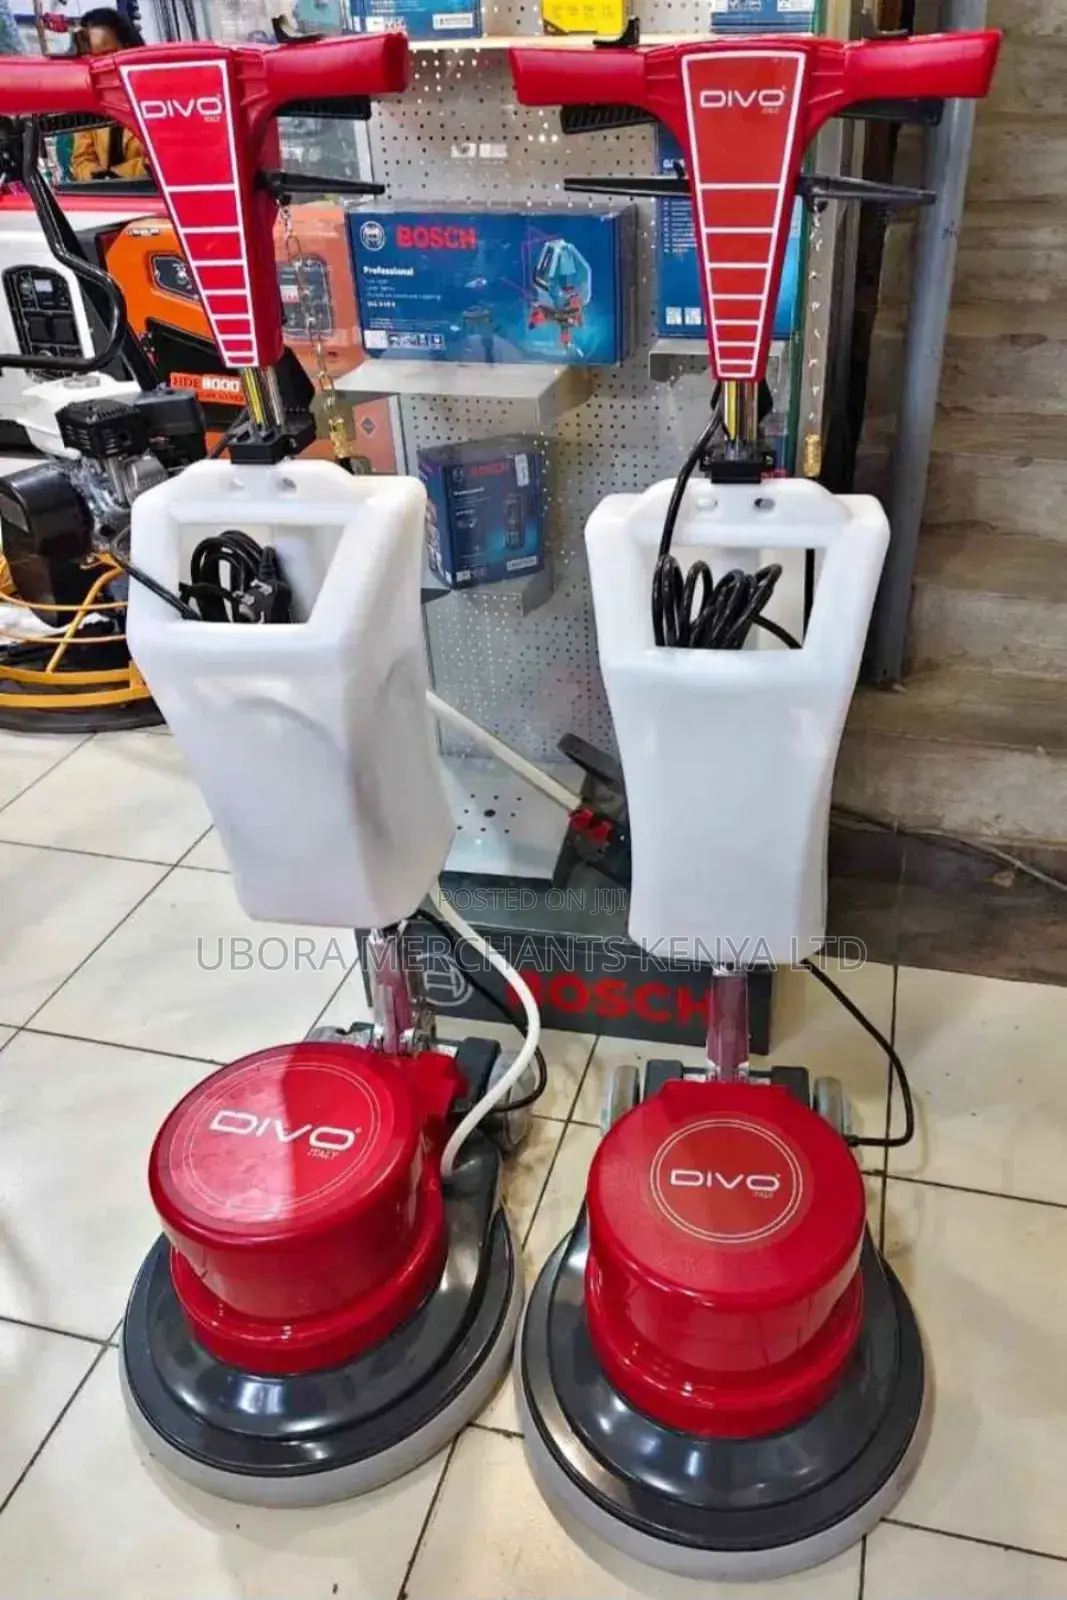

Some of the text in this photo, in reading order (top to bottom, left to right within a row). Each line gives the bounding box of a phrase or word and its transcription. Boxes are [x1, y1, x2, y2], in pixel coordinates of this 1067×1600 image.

[140, 96, 222, 119] DIVO
[700, 89, 785, 108] DIVO
[397, 225, 476, 249] BOSCH
[363, 266, 414, 276] Professional
[209, 1110, 356, 1151] DIVO
[306, 1148, 339, 1160] ITALY
[670, 1169, 780, 1191] DIVO
